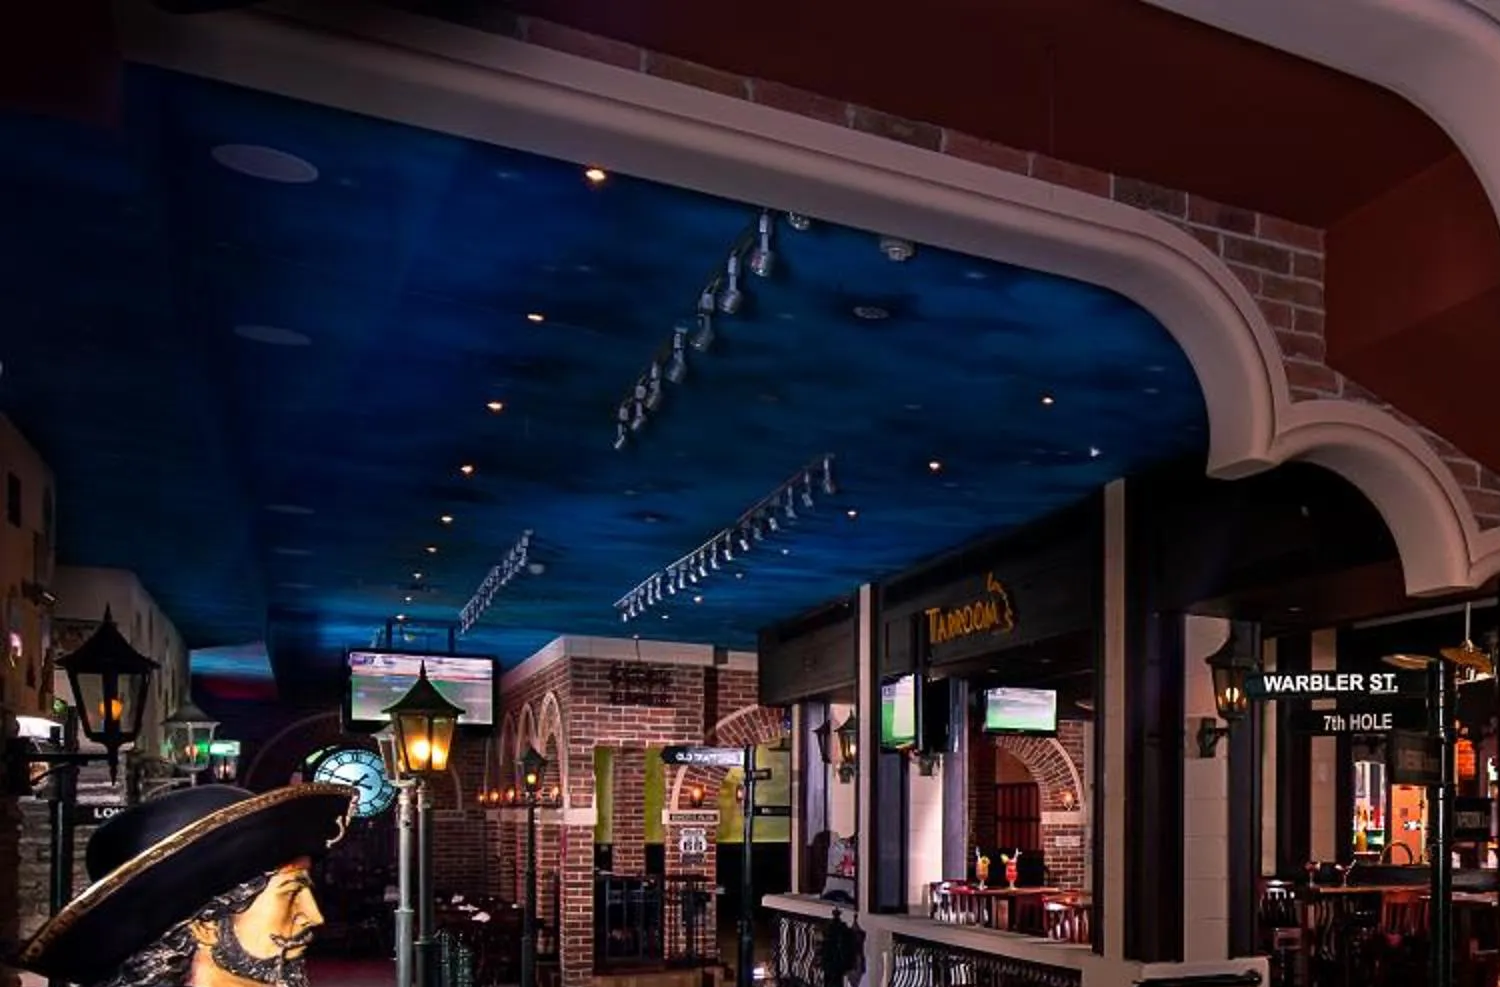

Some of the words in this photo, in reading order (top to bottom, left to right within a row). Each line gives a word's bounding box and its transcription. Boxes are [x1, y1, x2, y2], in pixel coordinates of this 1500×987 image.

[1263, 673, 1364, 693] WARBLER
[1369, 673, 1399, 694] ST.
[1323, 714, 1346, 731] 7th
[1349, 713, 1393, 731] HOLE
